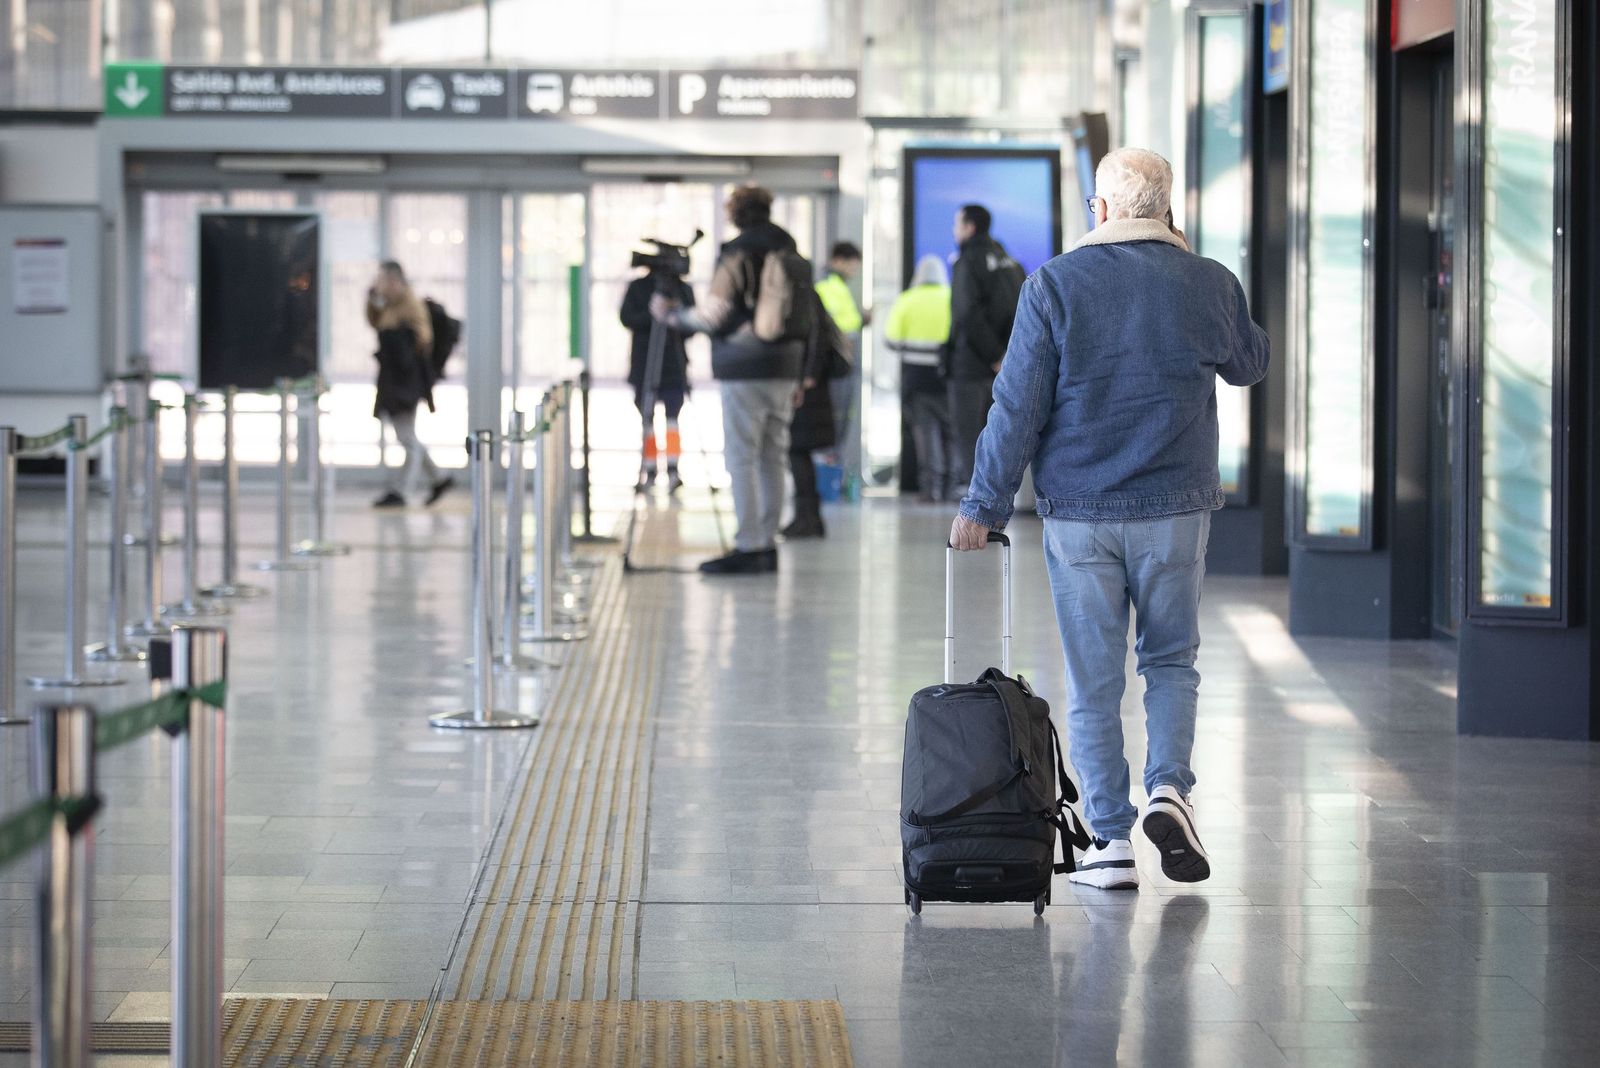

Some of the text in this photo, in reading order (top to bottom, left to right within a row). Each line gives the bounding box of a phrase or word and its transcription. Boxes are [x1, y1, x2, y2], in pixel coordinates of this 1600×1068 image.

[171, 70, 234, 94] Salida
[284, 72, 385, 95] Andaluces
[451, 73, 505, 96] Taxis
[570, 73, 655, 97] Autobús
[679, 74, 707, 114] P
[718, 73, 857, 99] Aparcamiento
[1327, 11, 1354, 173] ANTEQUERA
